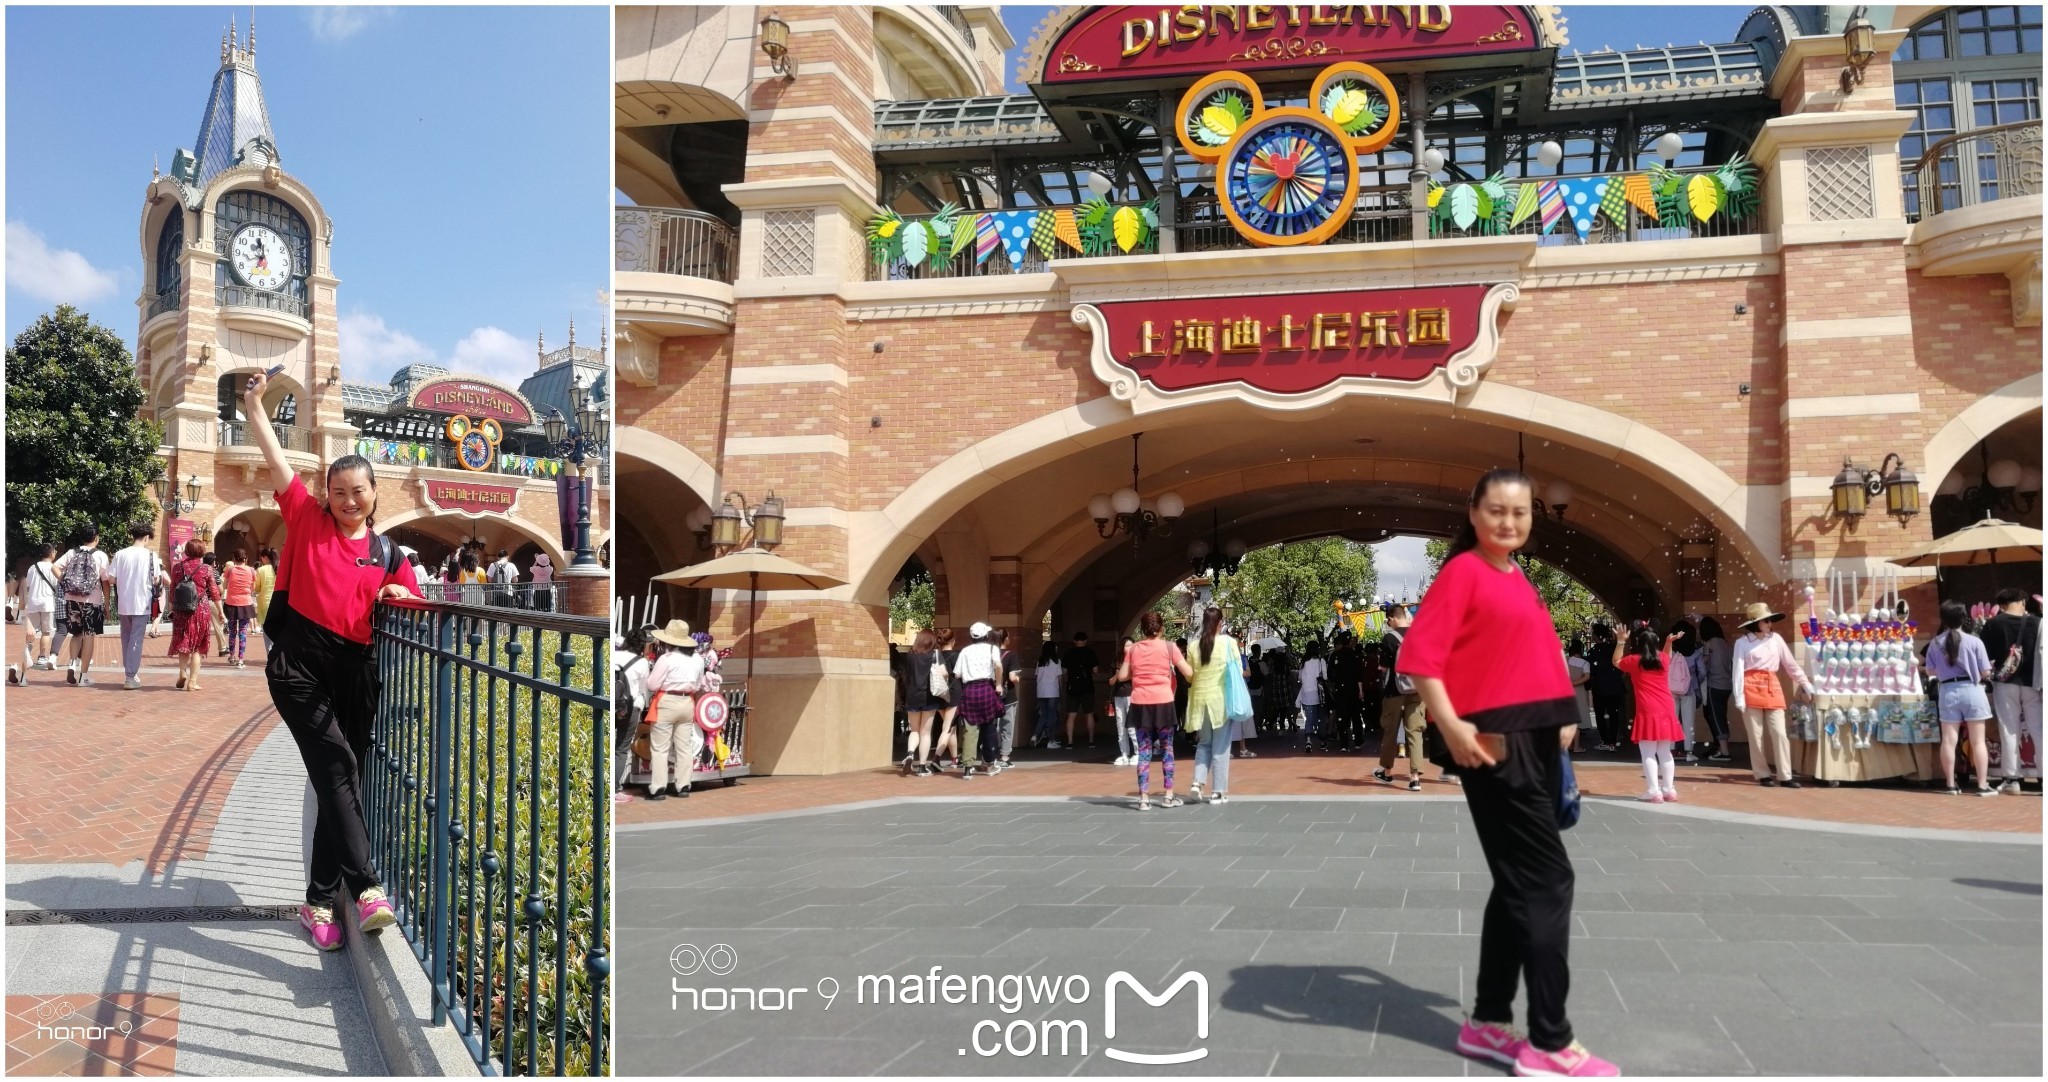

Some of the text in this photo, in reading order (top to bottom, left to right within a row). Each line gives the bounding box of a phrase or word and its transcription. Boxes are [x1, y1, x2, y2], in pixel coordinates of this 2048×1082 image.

[238, 238, 248, 246] 10
[280, 246, 286, 254] 2
[248, 272, 254, 280] 7
[1128, 307, 1452, 359] 上海迪士尼乐园
[460, 384, 490, 394] SHANGHAI
[435, 391, 514, 414] DISNEYLAND
[435, 487, 511, 504] 上海迪士尼乐园
